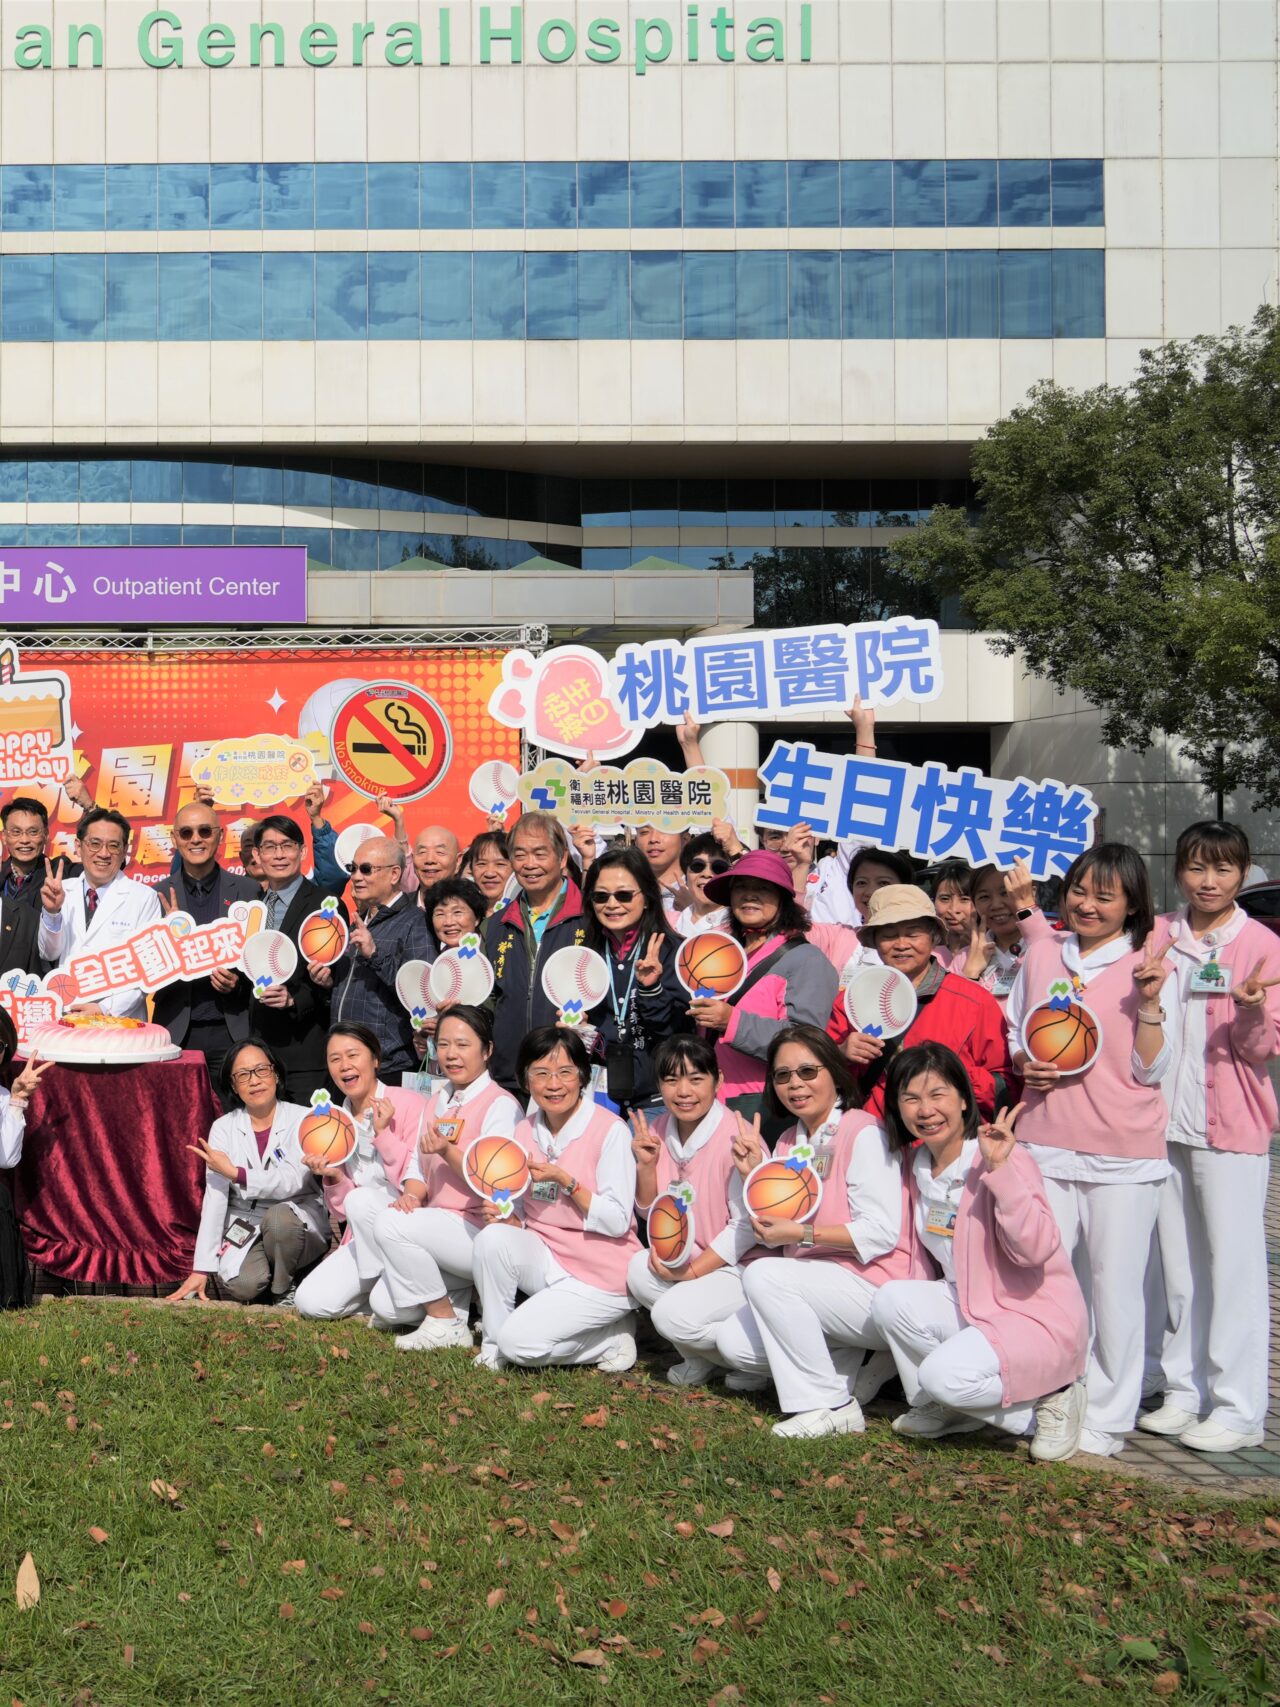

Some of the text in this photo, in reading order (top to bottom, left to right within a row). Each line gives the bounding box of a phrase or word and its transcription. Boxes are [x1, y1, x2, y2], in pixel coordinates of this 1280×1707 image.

[137, 7, 450, 68] General
[479, 4, 812, 76] Hospital
[93, 576, 280, 601] Outpatient Center
[616, 625, 935, 721] 桃園醫院
[561, 678, 609, 726] 生日
[335, 740, 346, 759] No
[570, 793, 607, 806] 福利部
[607, 779, 712, 805] 桃園醫院
[756, 745, 1093, 876] 生日快樂
[74, 926, 243, 994] 全民動起來
